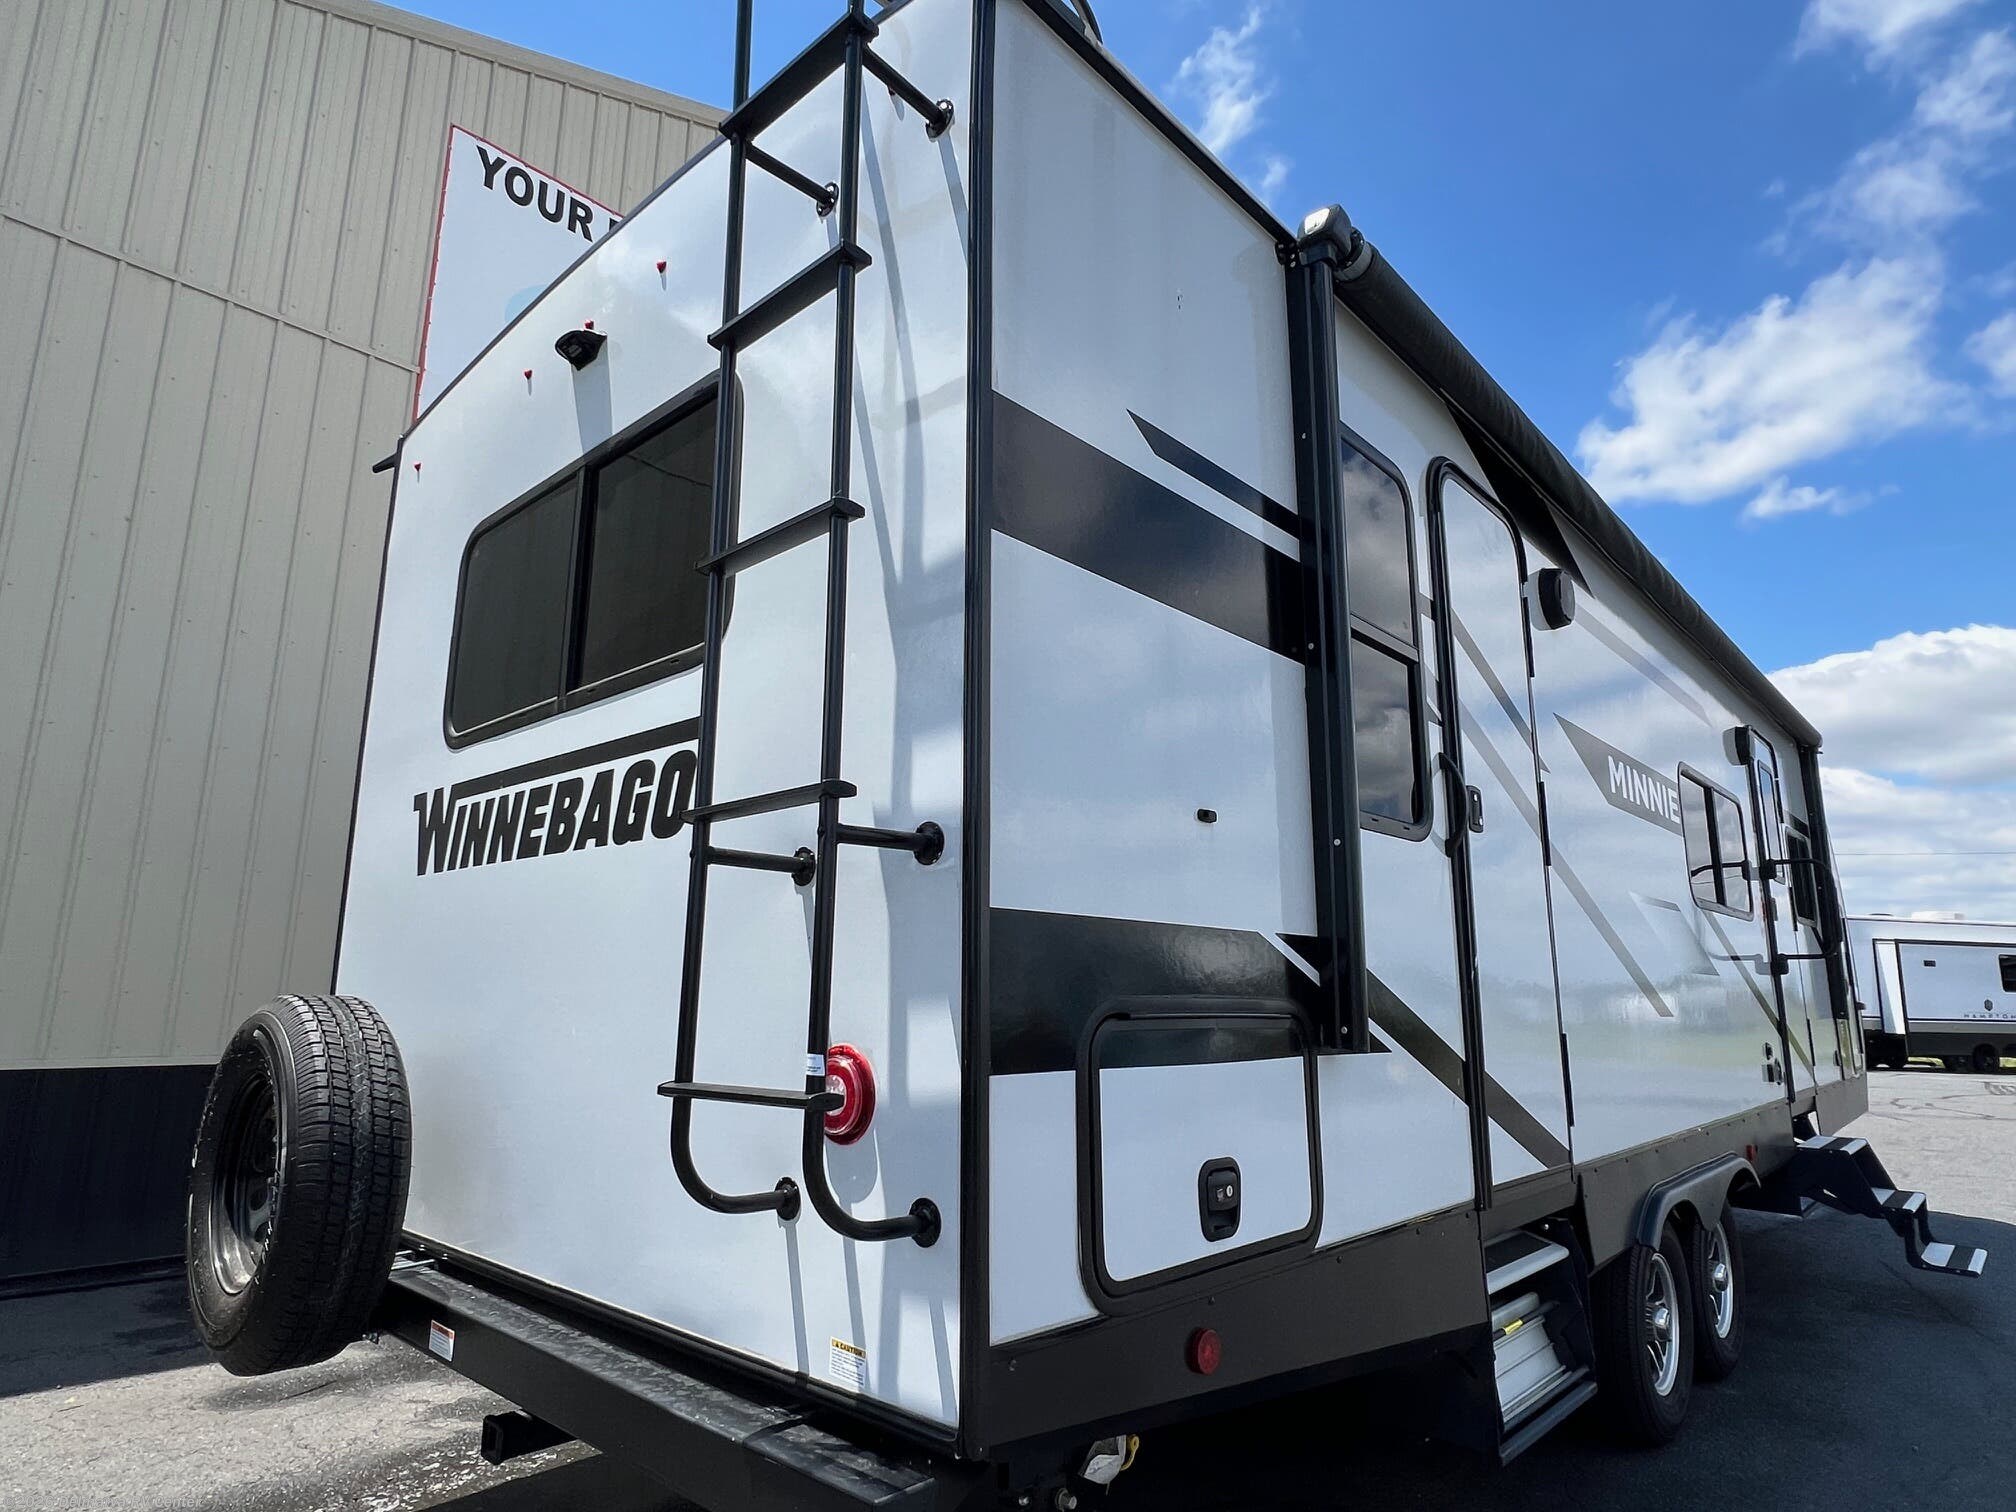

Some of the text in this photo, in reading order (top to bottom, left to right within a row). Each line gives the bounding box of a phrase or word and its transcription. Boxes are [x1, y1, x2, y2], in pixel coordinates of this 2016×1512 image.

[476, 145, 594, 243] YOUR
[413, 749, 698, 876] WINNEBAGO
[1607, 755, 1681, 824] MINNIE
